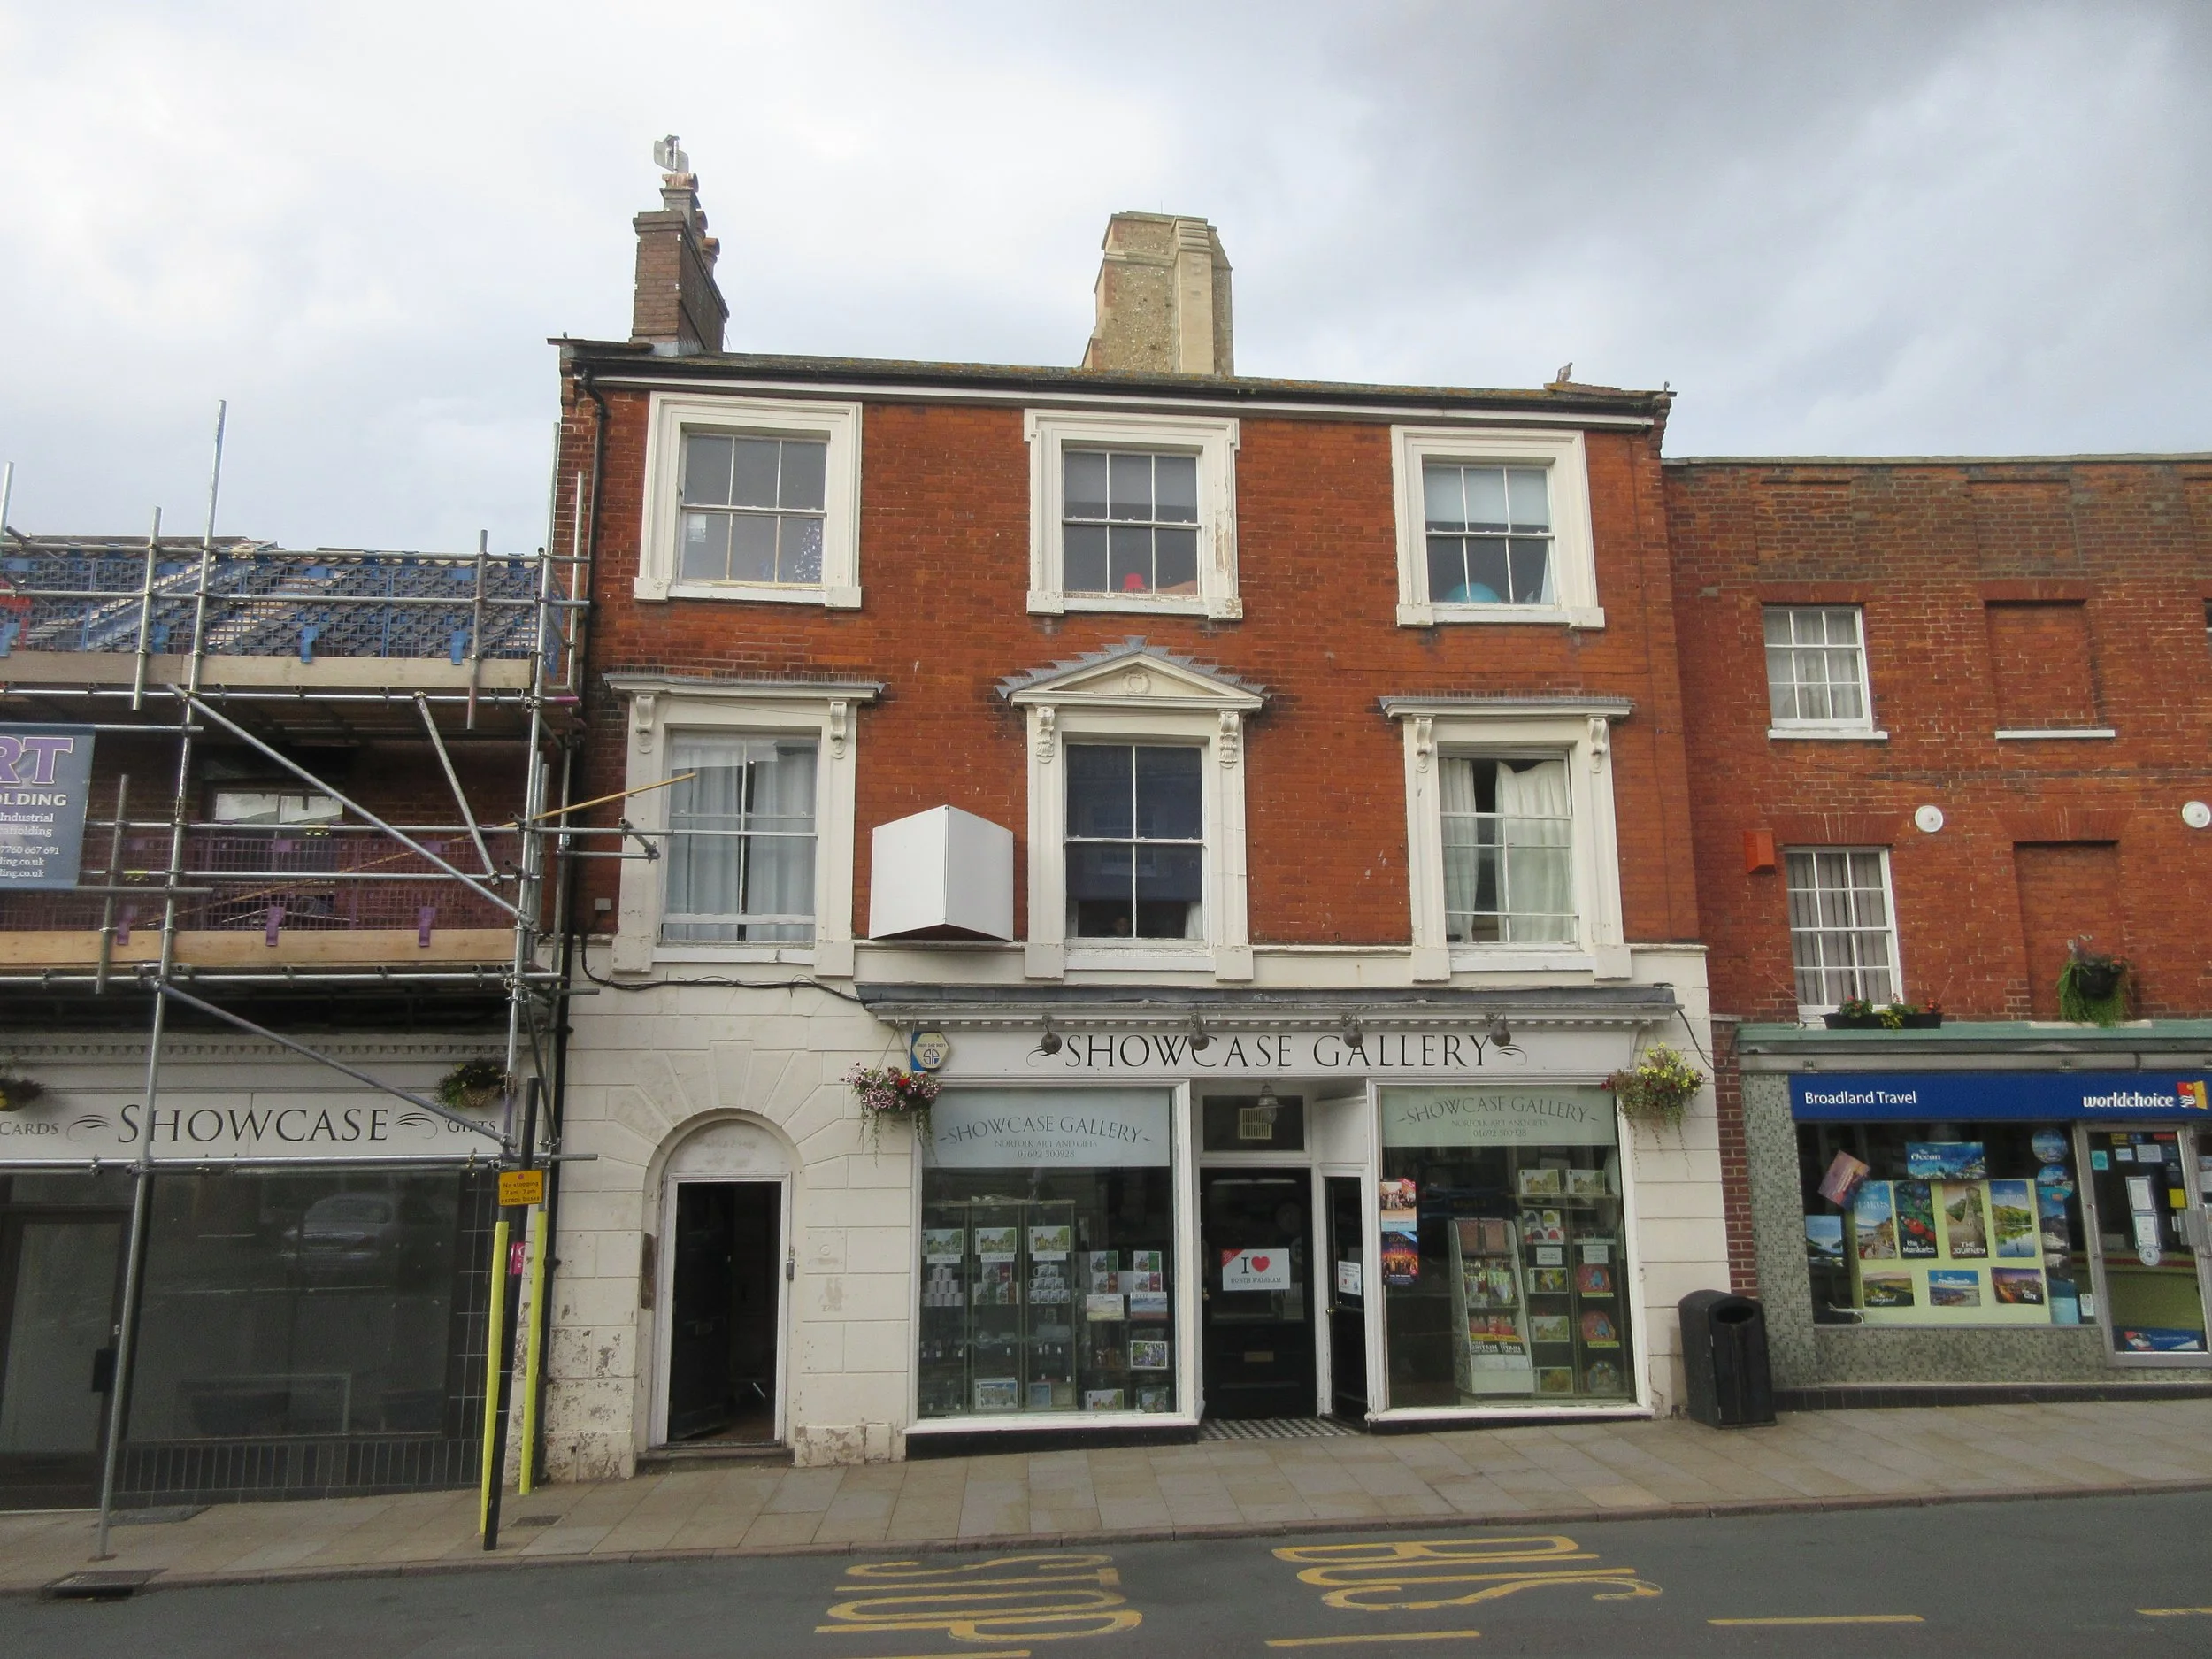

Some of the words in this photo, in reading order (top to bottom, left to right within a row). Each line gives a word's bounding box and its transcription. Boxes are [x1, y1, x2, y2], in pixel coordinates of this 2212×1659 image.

[0, 793, 67, 806] LDING
[0, 812, 54, 822] Industrial
[1065, 1034, 1292, 1068] SHOWCASE
[1313, 1034, 1490, 1068] GALLERY
[1805, 1091, 1874, 1104] Broadland
[1876, 1091, 1916, 1104] Travel
[2083, 1092, 2174, 1107] worldchoice
[1406, 1096, 1505, 1125] SHOWCASE
[1511, 1096, 1588, 1123] GALLERY
[0, 1121, 59, 1135] CARDS
[118, 1104, 388, 1143] SHOWCASE
[948, 1116, 1055, 1145] SHOWCASE
[1060, 1116, 1142, 1144] GALLERY
[995, 1139, 1033, 1148] NORFOLK
[1036, 1139, 1053, 1148] ART
[1056, 1139, 1075, 1148] AND
[1241, 1256, 1249, 1274] I
[1271, 1536, 1663, 1610] BUS
[815, 1554, 1143, 1642] STOP
